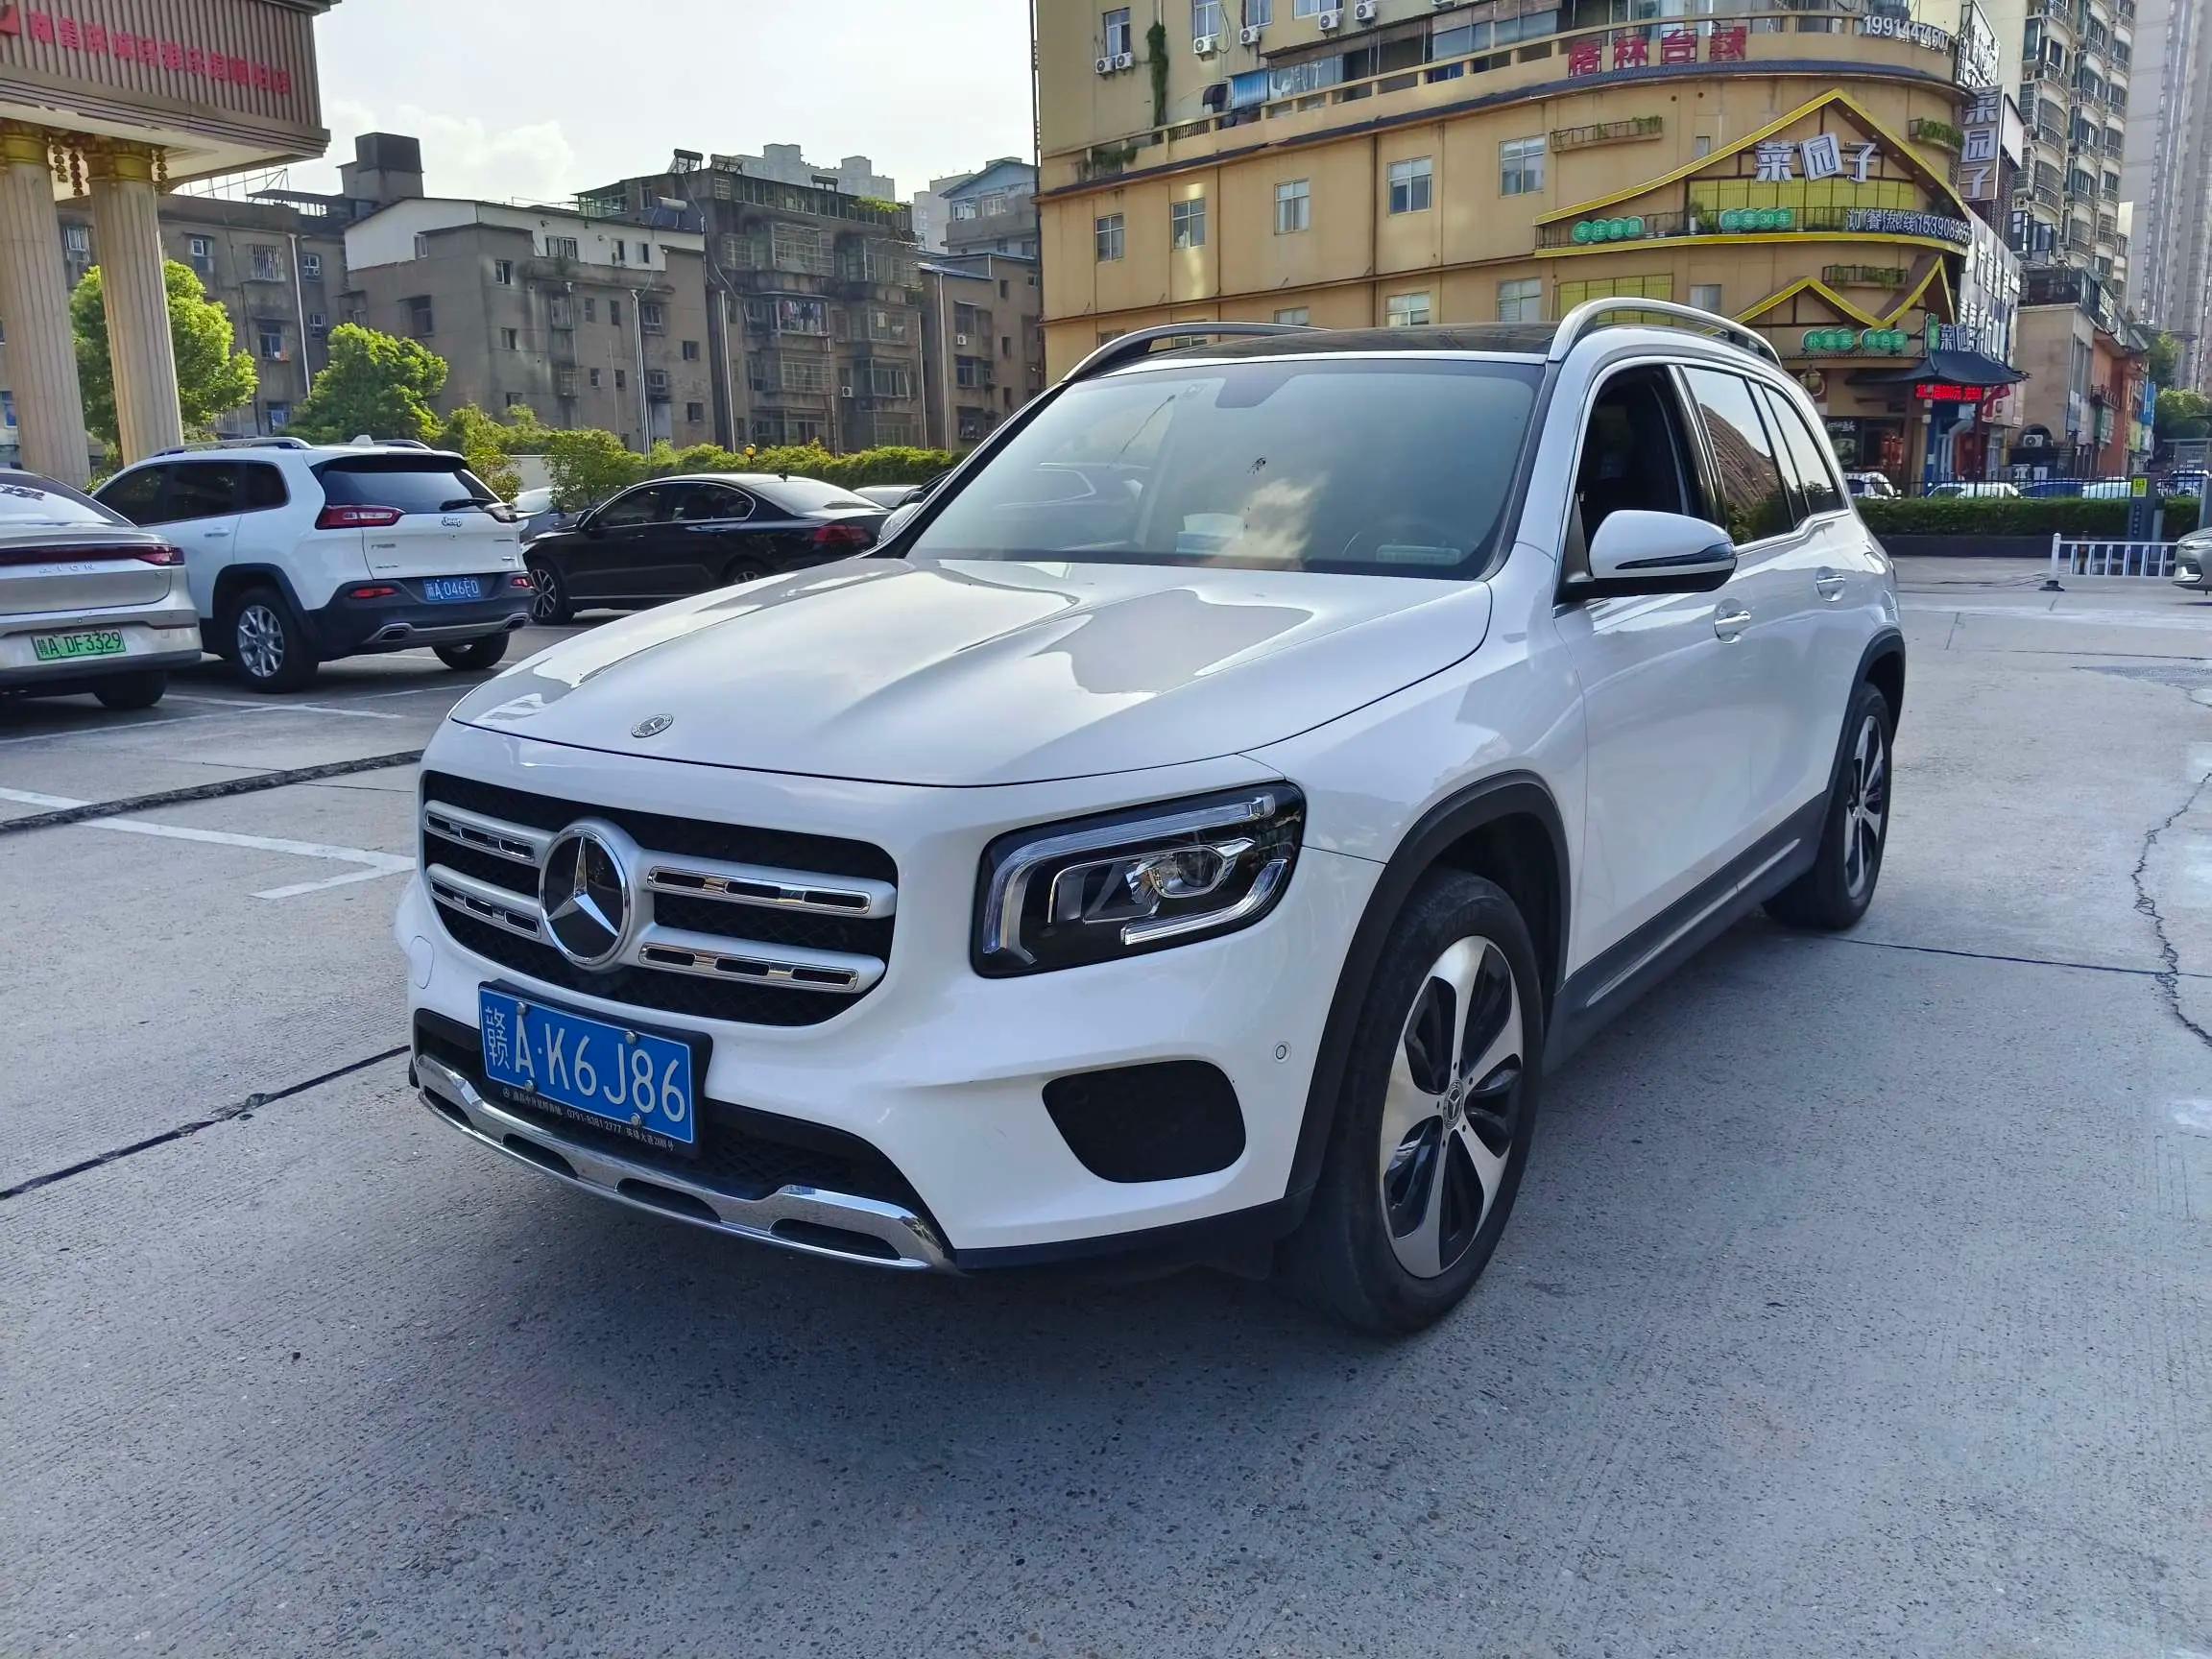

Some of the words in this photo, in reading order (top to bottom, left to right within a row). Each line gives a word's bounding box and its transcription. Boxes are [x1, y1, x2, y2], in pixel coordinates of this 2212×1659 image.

[1754, 132, 1878, 183] 菜园子
[442, 517, 462, 527] Jeep
